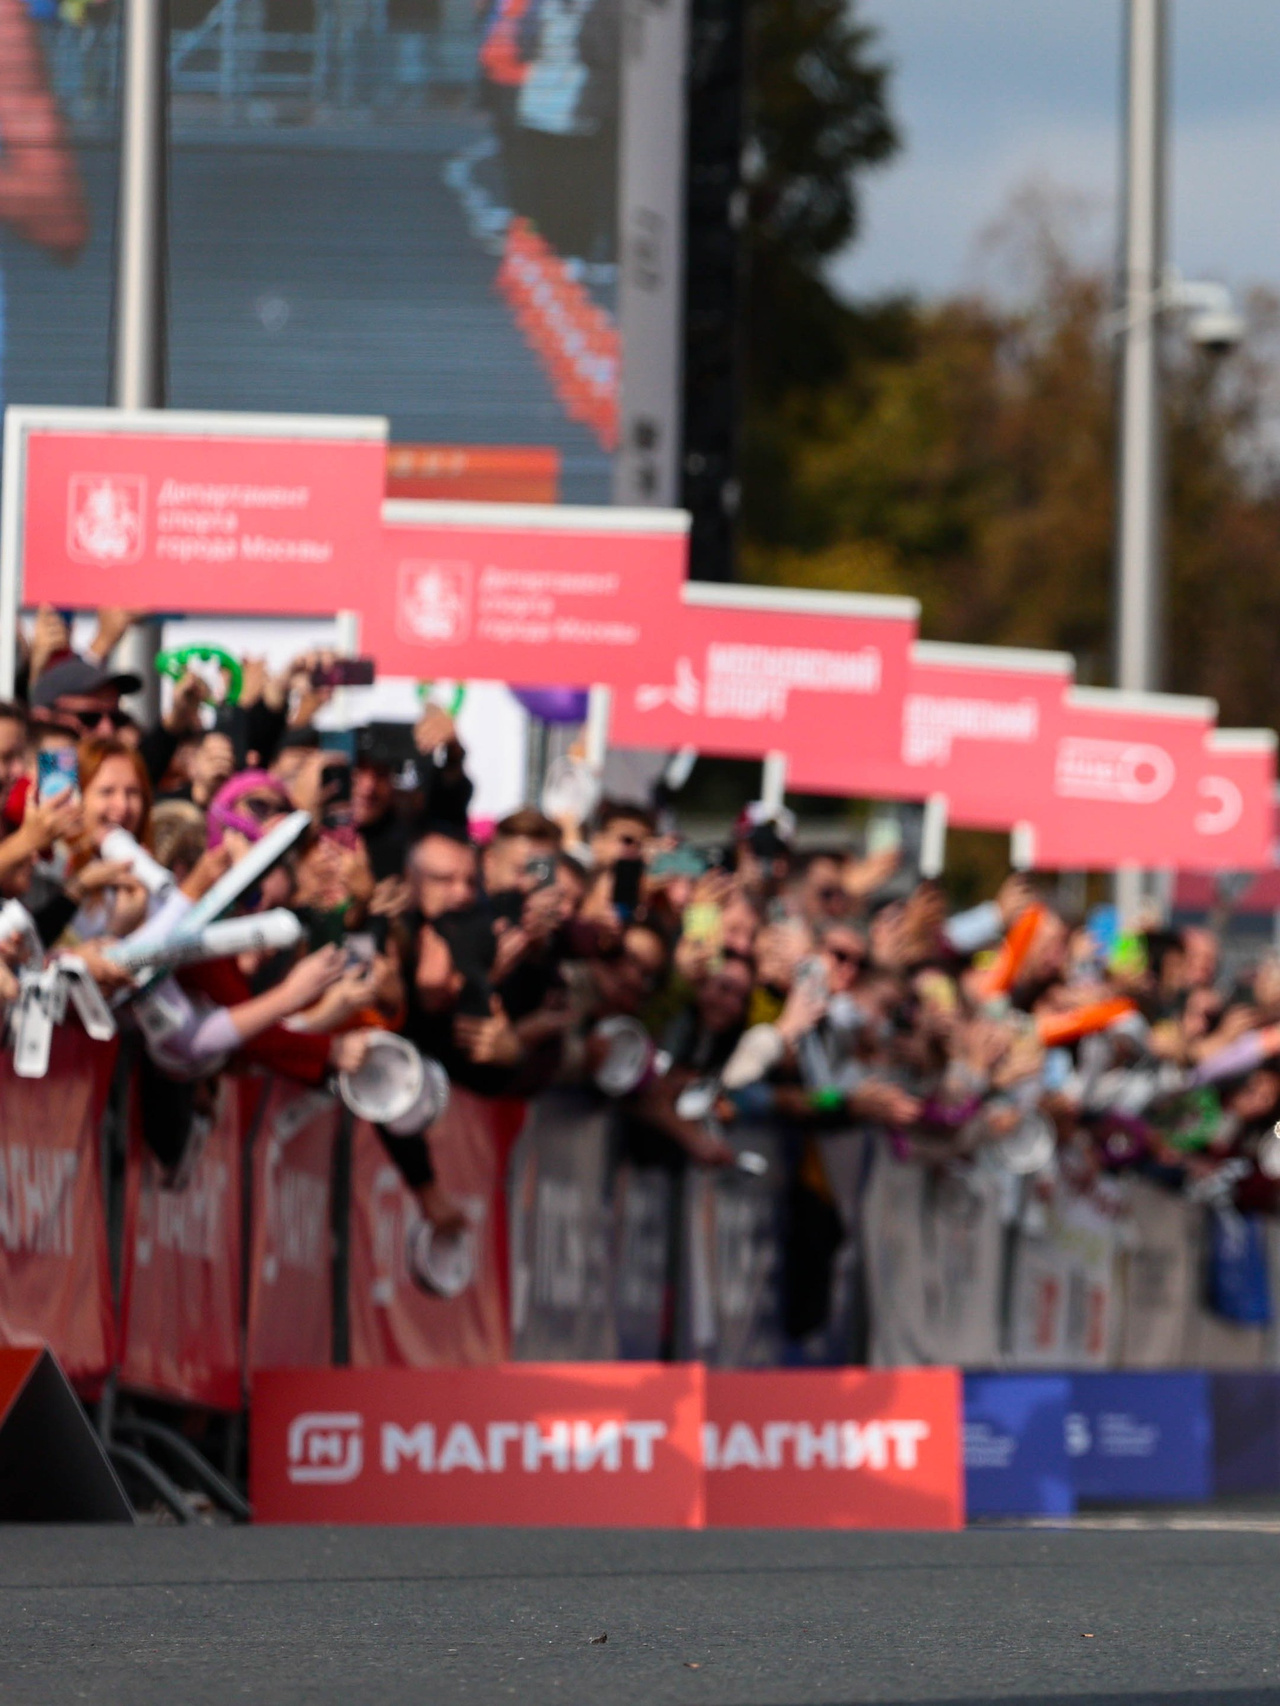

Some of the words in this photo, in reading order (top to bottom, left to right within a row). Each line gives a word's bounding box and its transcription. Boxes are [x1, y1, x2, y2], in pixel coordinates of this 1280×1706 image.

[157, 479, 310, 508] Департамент
[157, 508, 237, 534] спорта
[156, 534, 236, 564] города
[241, 536, 333, 563] Москвы
[380, 1420, 667, 1474] МАГНИТ
